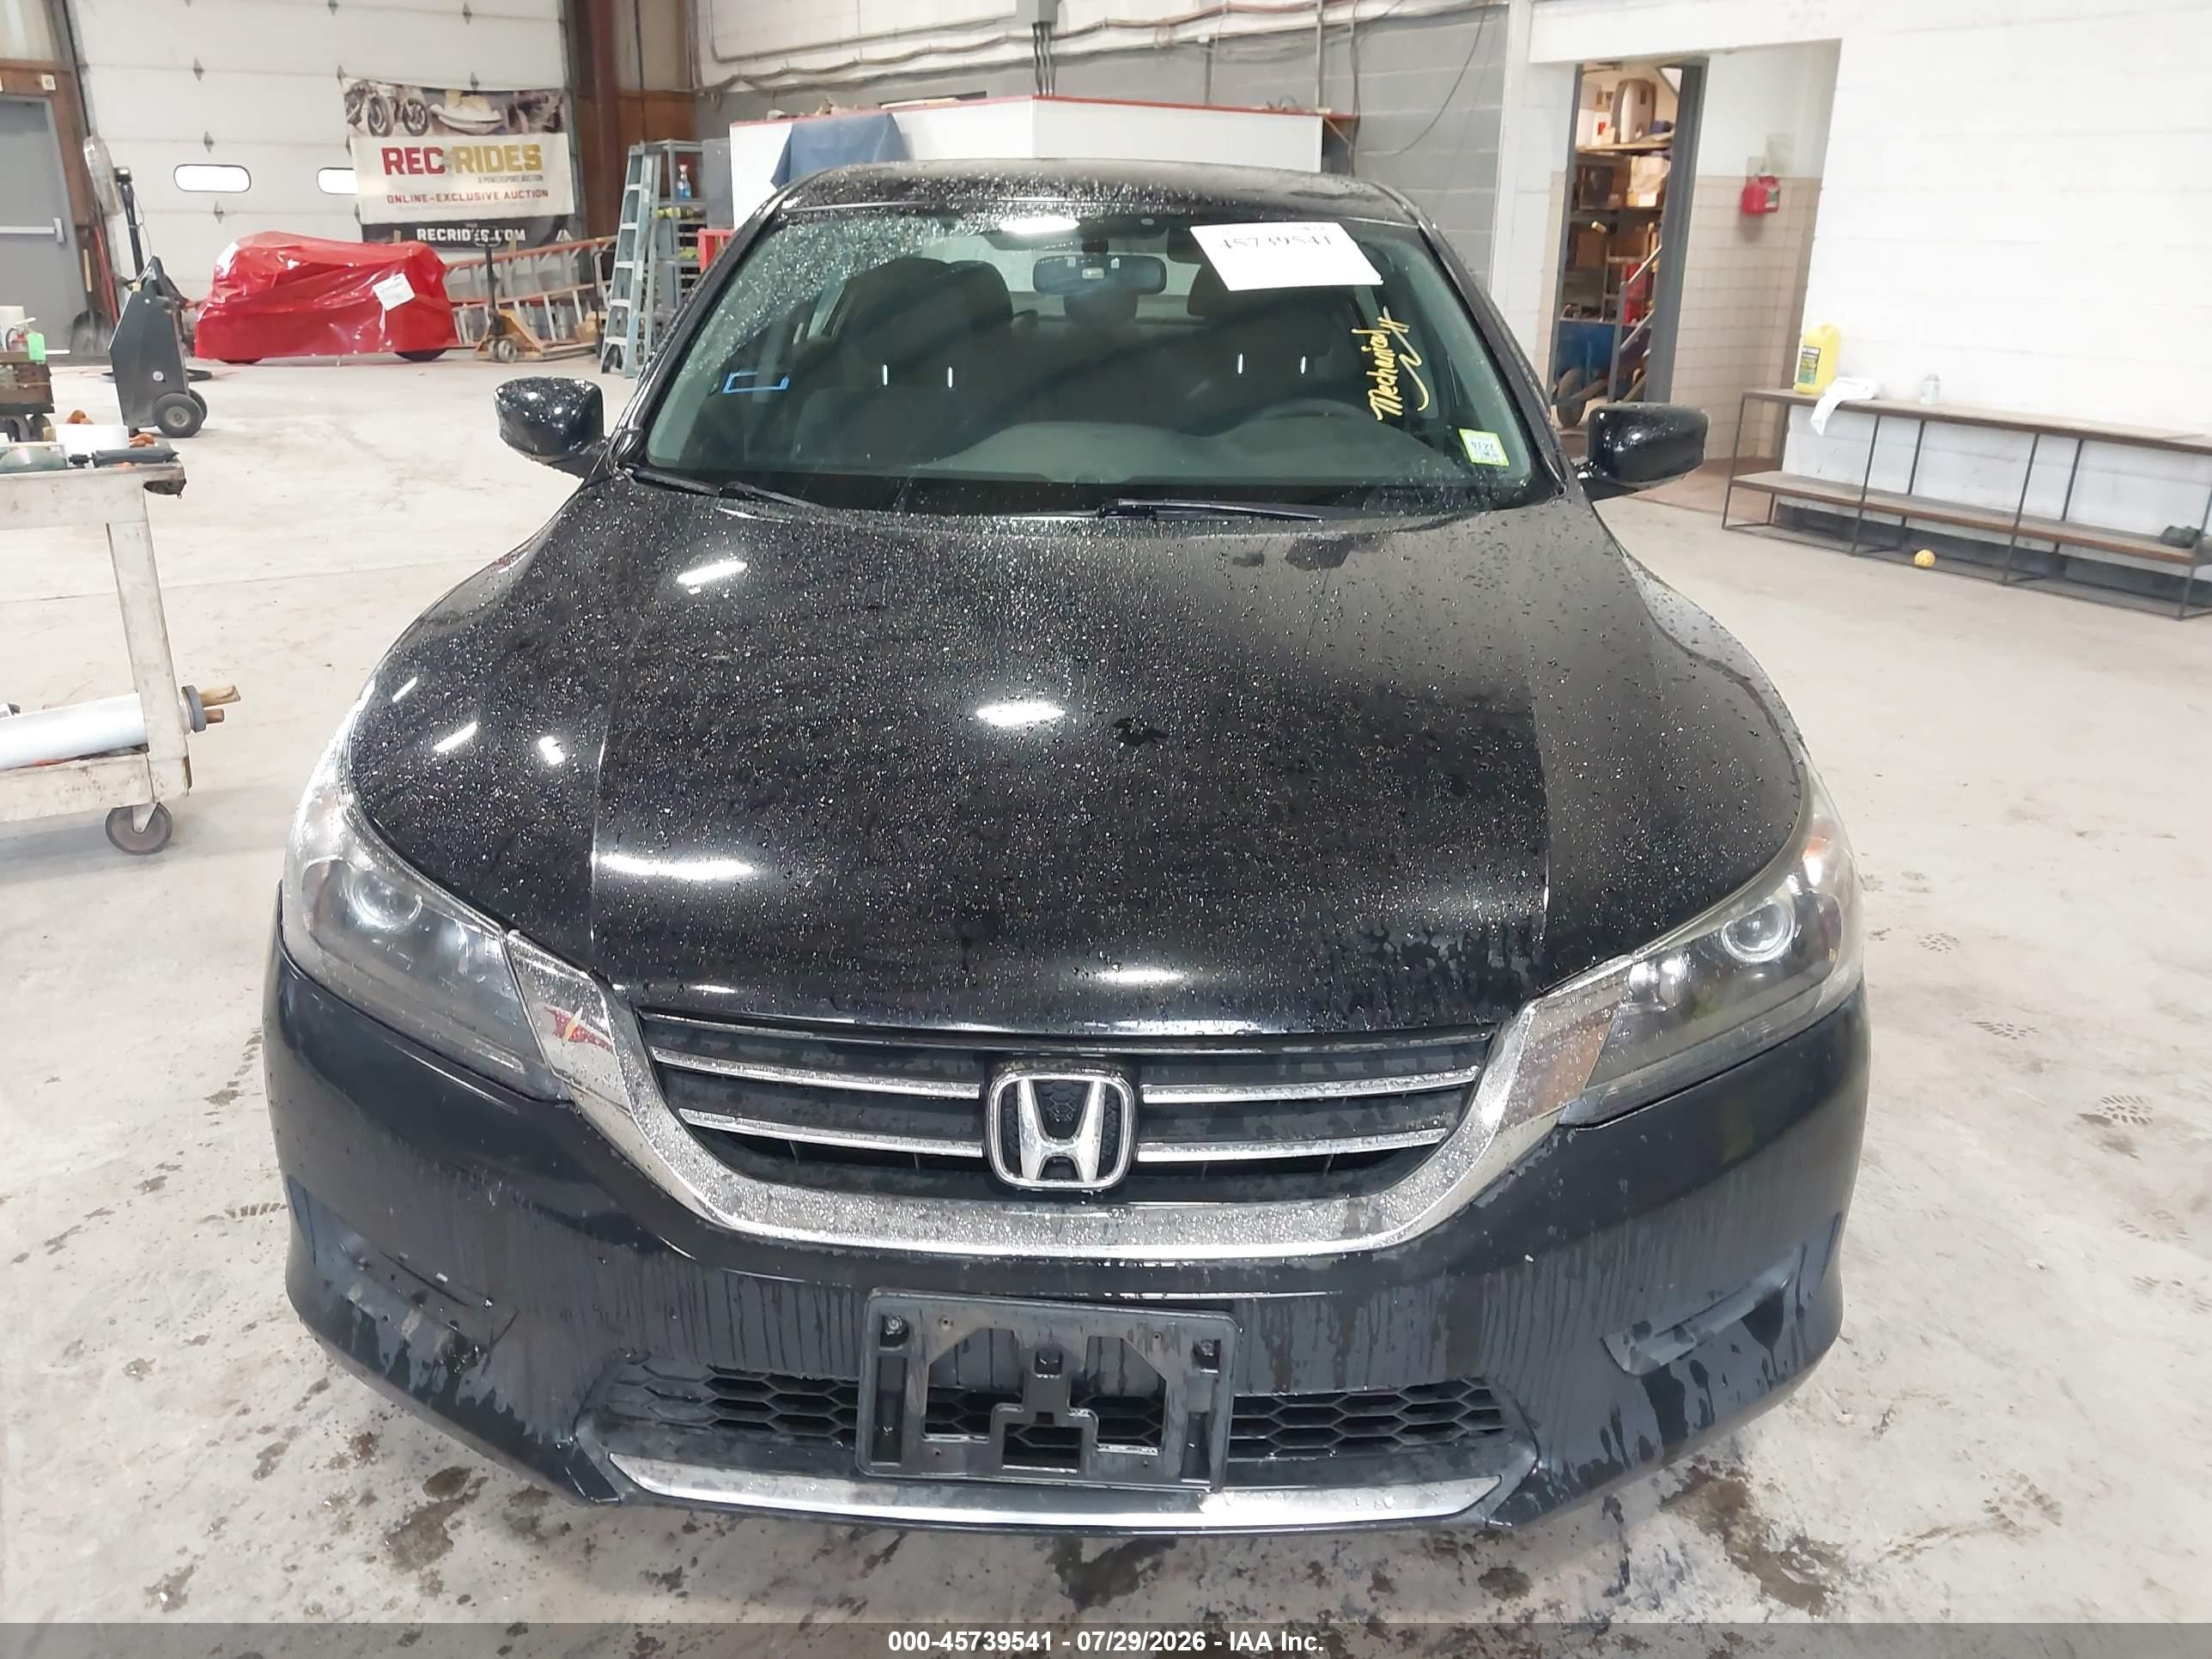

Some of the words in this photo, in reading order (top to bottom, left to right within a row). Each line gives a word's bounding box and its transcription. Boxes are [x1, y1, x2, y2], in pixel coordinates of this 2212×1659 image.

[381, 146, 446, 175] REC
[452, 143, 544, 173] RIDES
[386, 191, 500, 204] ONLINE-EXCLUSIVE
[504, 189, 550, 200] AUCTION
